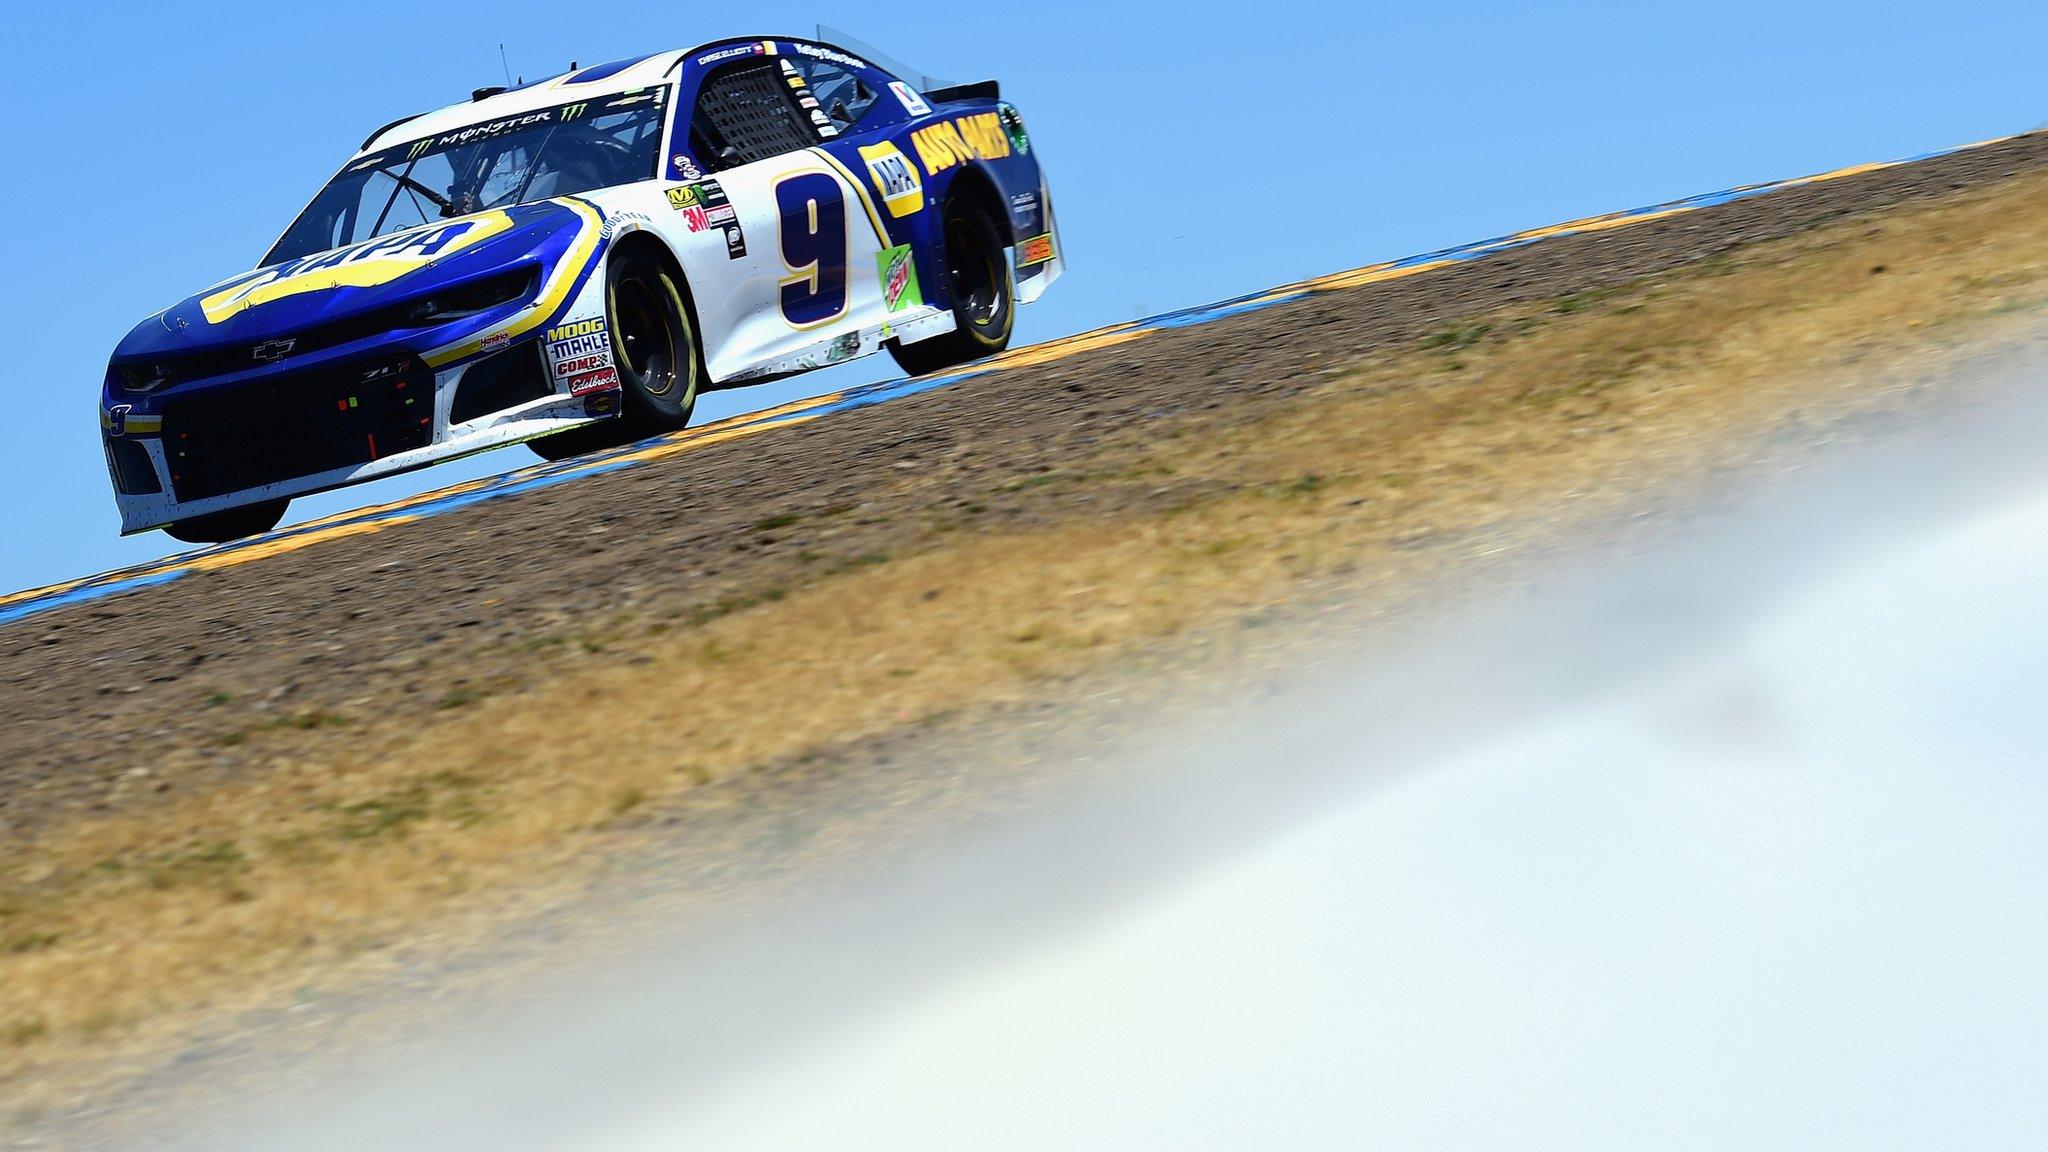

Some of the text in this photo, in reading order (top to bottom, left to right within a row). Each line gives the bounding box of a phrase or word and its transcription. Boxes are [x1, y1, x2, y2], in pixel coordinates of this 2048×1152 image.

[438, 111, 551, 146] MONSTER
[872, 156, 918, 196] NAPA
[683, 205, 709, 233] 3M
[773, 169, 849, 330] 9
[547, 319, 604, 343] MOOG
[553, 333, 610, 359] MAHLE
[557, 355, 598, 375] COMP
[571, 372, 618, 393] Edelbrock
[110, 404, 132, 437] 9
